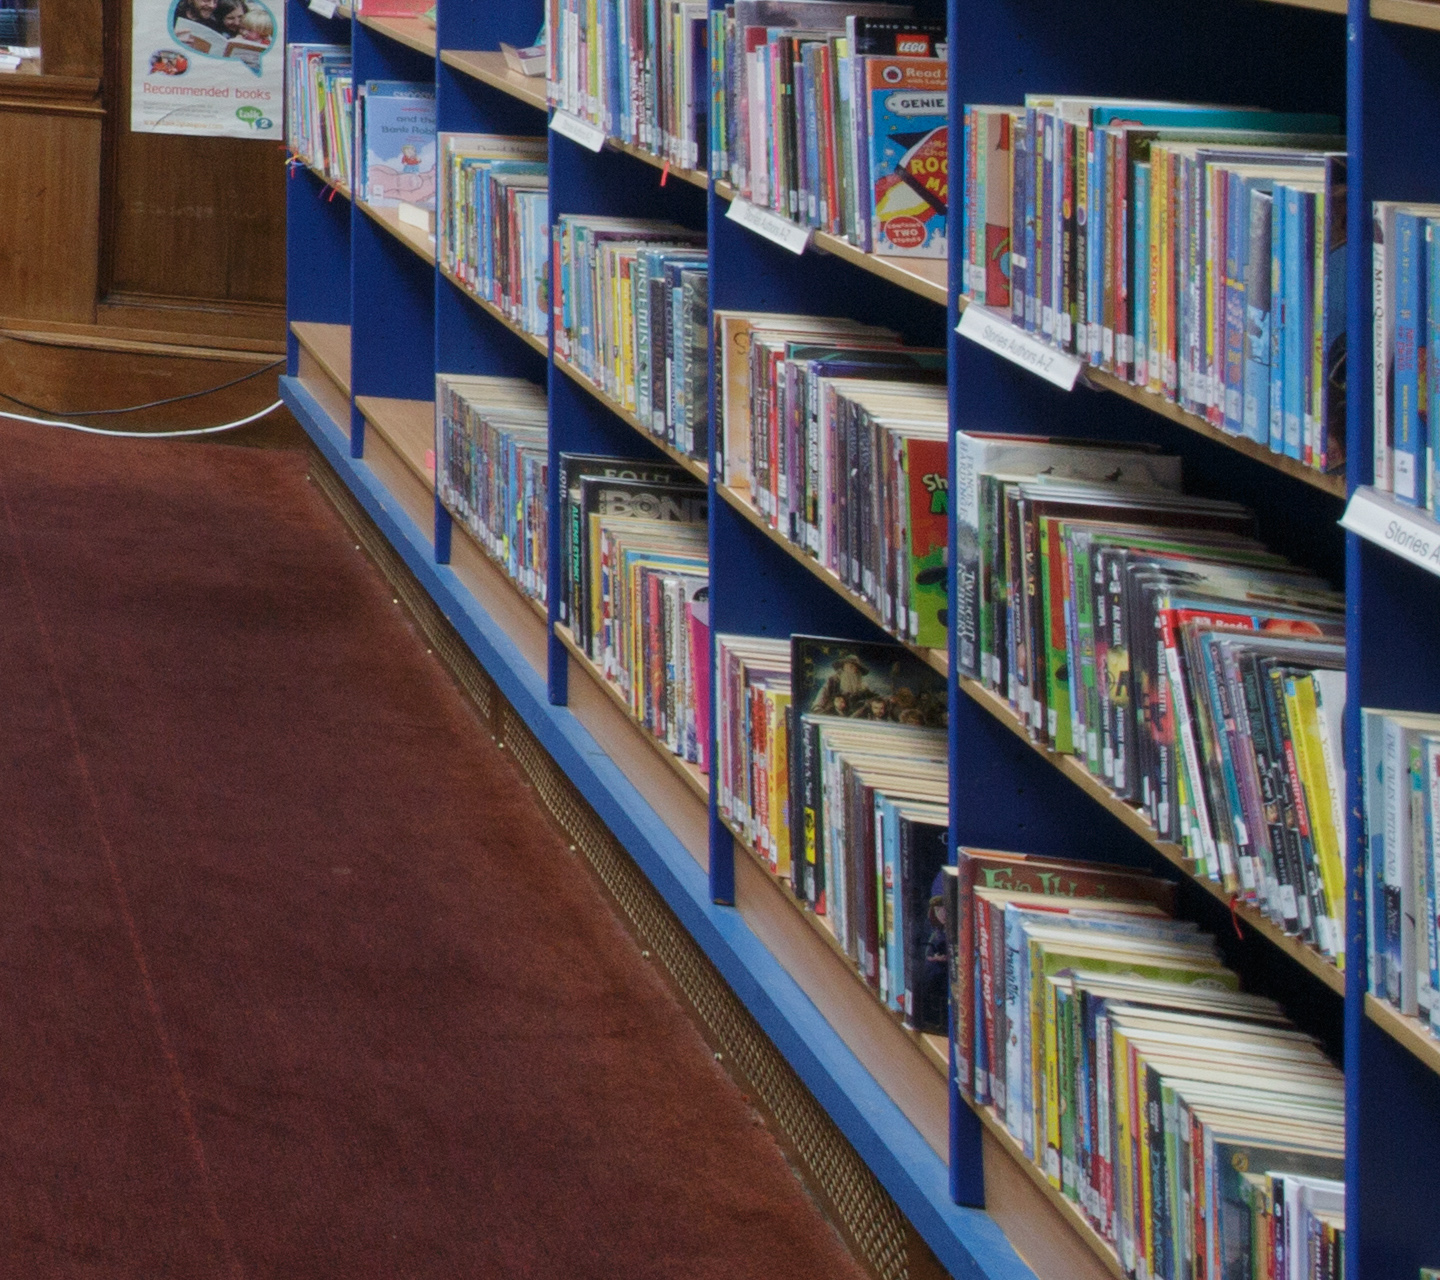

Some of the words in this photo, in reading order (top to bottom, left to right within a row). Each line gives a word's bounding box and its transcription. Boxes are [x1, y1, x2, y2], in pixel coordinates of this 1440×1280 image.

[898, 41, 927, 53] LEGO
[905, 67, 941, 78] Read
[143, 82, 229, 98] Recommended
[235, 88, 271, 100] books
[901, 98, 945, 109] GENIE
[239, 109, 261, 118] talk
[893, 228, 918, 238] TWO
[638, 258, 648, 344] ARTEMIS
[1373, 268, 1383, 303] MARY
[683, 282, 694, 370] ARTEMIS
[1373, 306, 1383, 349] QUEEN
[982, 325, 1006, 350] Stories
[1006, 340, 1037, 365] Authors
[1037, 358, 1055, 372] A-Z
[1373, 360, 1383, 397] SCOTS
[571, 506, 580, 544] ALIENS
[1385, 520, 1430, 557] Stories
[572, 545, 580, 582] STINK!
[963, 571, 975, 642] TWILIGHT
[1111, 605, 1121, 620] ARK
[1111, 622, 1122, 645] ANGEL
[977, 902, 987, 925] one
[979, 927, 991, 958] dog
[1426, 898, 1437, 971] HUNTER
[982, 973, 993, 1003] boy
